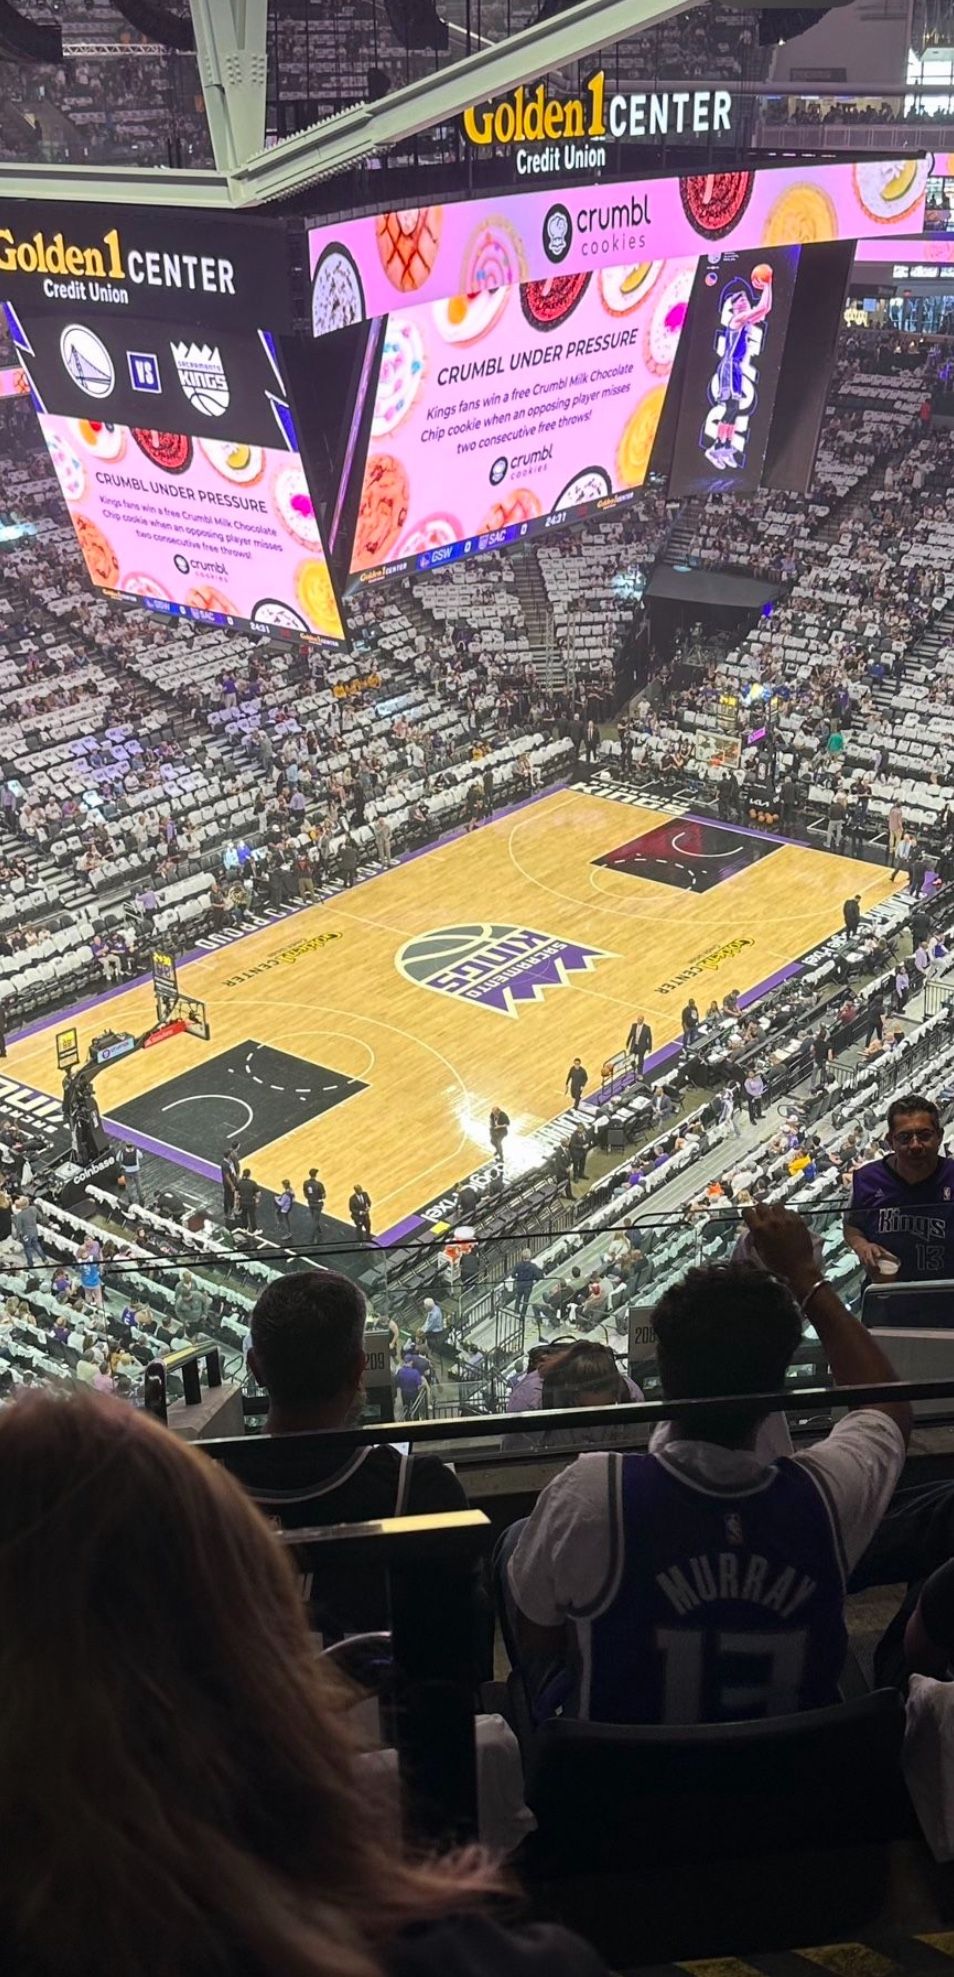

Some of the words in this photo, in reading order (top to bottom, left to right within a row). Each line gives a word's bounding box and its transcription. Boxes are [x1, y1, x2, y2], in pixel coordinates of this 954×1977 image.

[609, 90, 731, 138] CENTER
[516, 147, 560, 175] Credit
[564, 144, 606, 170] Union
[576, 193, 652, 234] crumbl
[580, 232, 646, 256] cookies
[127, 250, 236, 295] CENTER
[43, 278, 87, 301] Credit
[88, 282, 129, 305] Union
[133, 359, 155, 386] VS
[437, 356, 505, 387] CRUMBL
[509, 344, 563, 371] UNDER
[565, 328, 639, 360] PRESSURE
[180, 370, 224, 389] KINGS
[426, 404, 457, 421] Kings
[459, 397, 481, 414] fans
[482, 393, 501, 408] win
[502, 394, 509, 403] a
[511, 386, 531, 401] free
[532, 377, 568, 397] Crumbl
[569, 373, 589, 387] Milk
[589, 362, 634, 382] Chocolate
[420, 427, 446, 443] Chip
[447, 418, 482, 437] cookie
[484, 411, 511, 428] when
[513, 409, 526, 421] an
[527, 397, 571, 418] opposing
[571, 390, 600, 408] player
[602, 382, 632, 399] misses
[457, 440, 477, 454] two
[478, 424, 536, 449] consecutive
[538, 418, 557, 434] free
[557, 408, 593, 428] throws!
[510, 443, 553, 470] crumbl
[95, 471, 149, 492] CRUMBL
[150, 481, 196, 501] UNDER
[197, 489, 269, 514] PRESSURE
[102, 508, 121, 521] Chip
[185, 526, 225, 543] opposing
[181, 510, 213, 524] Crumbl
[213, 516, 232, 528] Milk
[233, 520, 278, 537] Chocolate
[488, 530, 507, 545] SAC
[189, 558, 229, 576] crumbl
[431, 546, 454, 563] GSW
[569, 781, 691, 817] KINGS
[194, 914, 270, 950] PROUD
[220, 959, 280, 987] CENTER
[426, 929, 552, 993] KINGS
[464, 942, 568, 999] SACRAMENTO
[653, 966, 704, 995] CENTER
[73, 1156, 116, 1185] coinbase
[878, 1207, 946, 1242] Kings
[914, 1243, 946, 1271] 13
[655, 1552, 817, 1617] MURRAY
